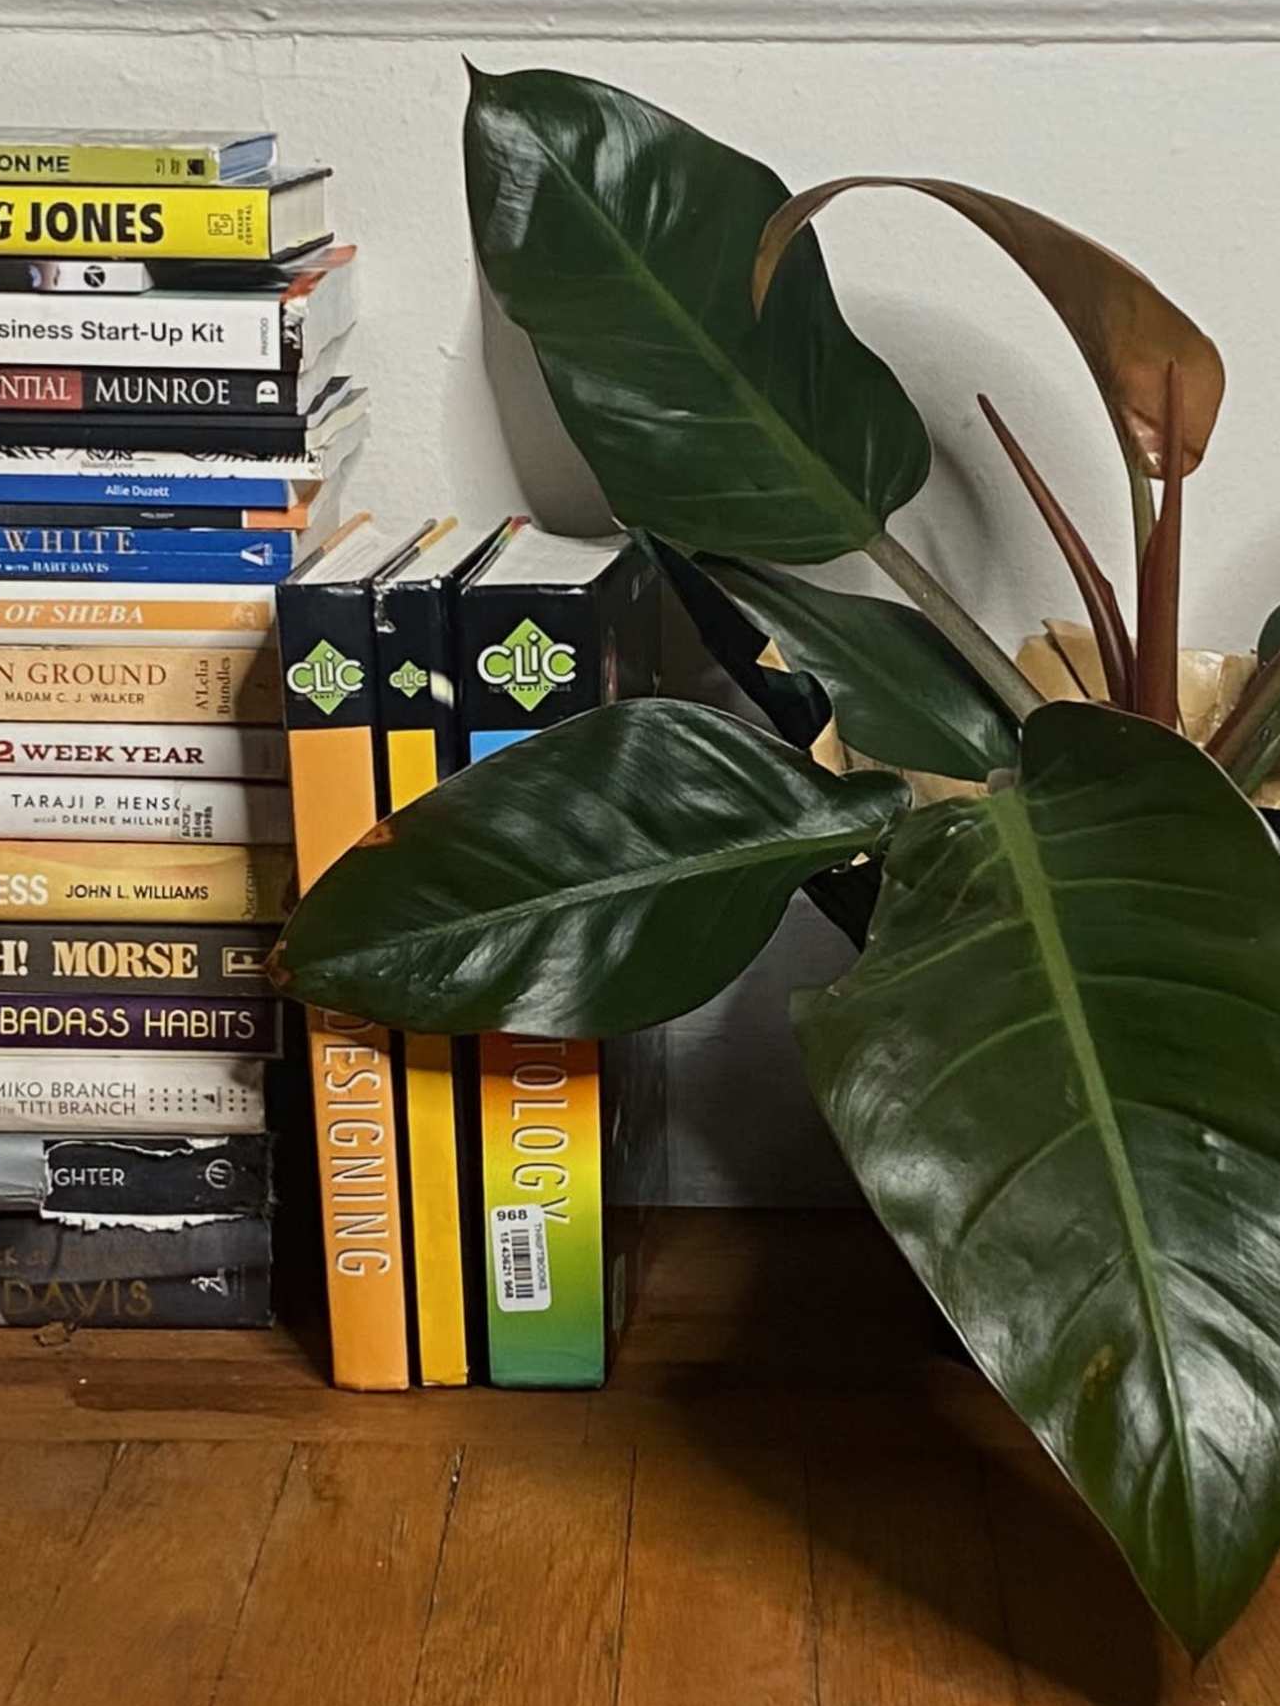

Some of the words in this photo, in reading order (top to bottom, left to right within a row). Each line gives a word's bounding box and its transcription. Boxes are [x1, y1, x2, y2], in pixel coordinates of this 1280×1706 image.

[26, 201, 164, 243] JONES
[80, 321, 184, 346] Start-Up
[192, 322, 224, 343] Kit
[95, 377, 230, 405] MUNROE
[2, 529, 138, 554] WHITE
[51, 605, 145, 624] SHEBA
[28, 663, 167, 686] GROUND
[217, 657, 232, 715] Bundles
[91, 693, 145, 705] WALKER
[23, 743, 115, 762] WEEK
[121, 746, 204, 765] YEAR
[11, 794, 84, 809] TARAJI
[65, 884, 111, 899] JOHN
[133, 885, 209, 900] WILLIAMS
[52, 941, 198, 978] MORSE
[0, 1006, 130, 1037] BADASS
[144, 1008, 255, 1039] HABITS
[50, 1082, 137, 1099] BRANCH
[58, 1101, 137, 1116] BRANCH
[3, 1280, 153, 1318] DAVIS
